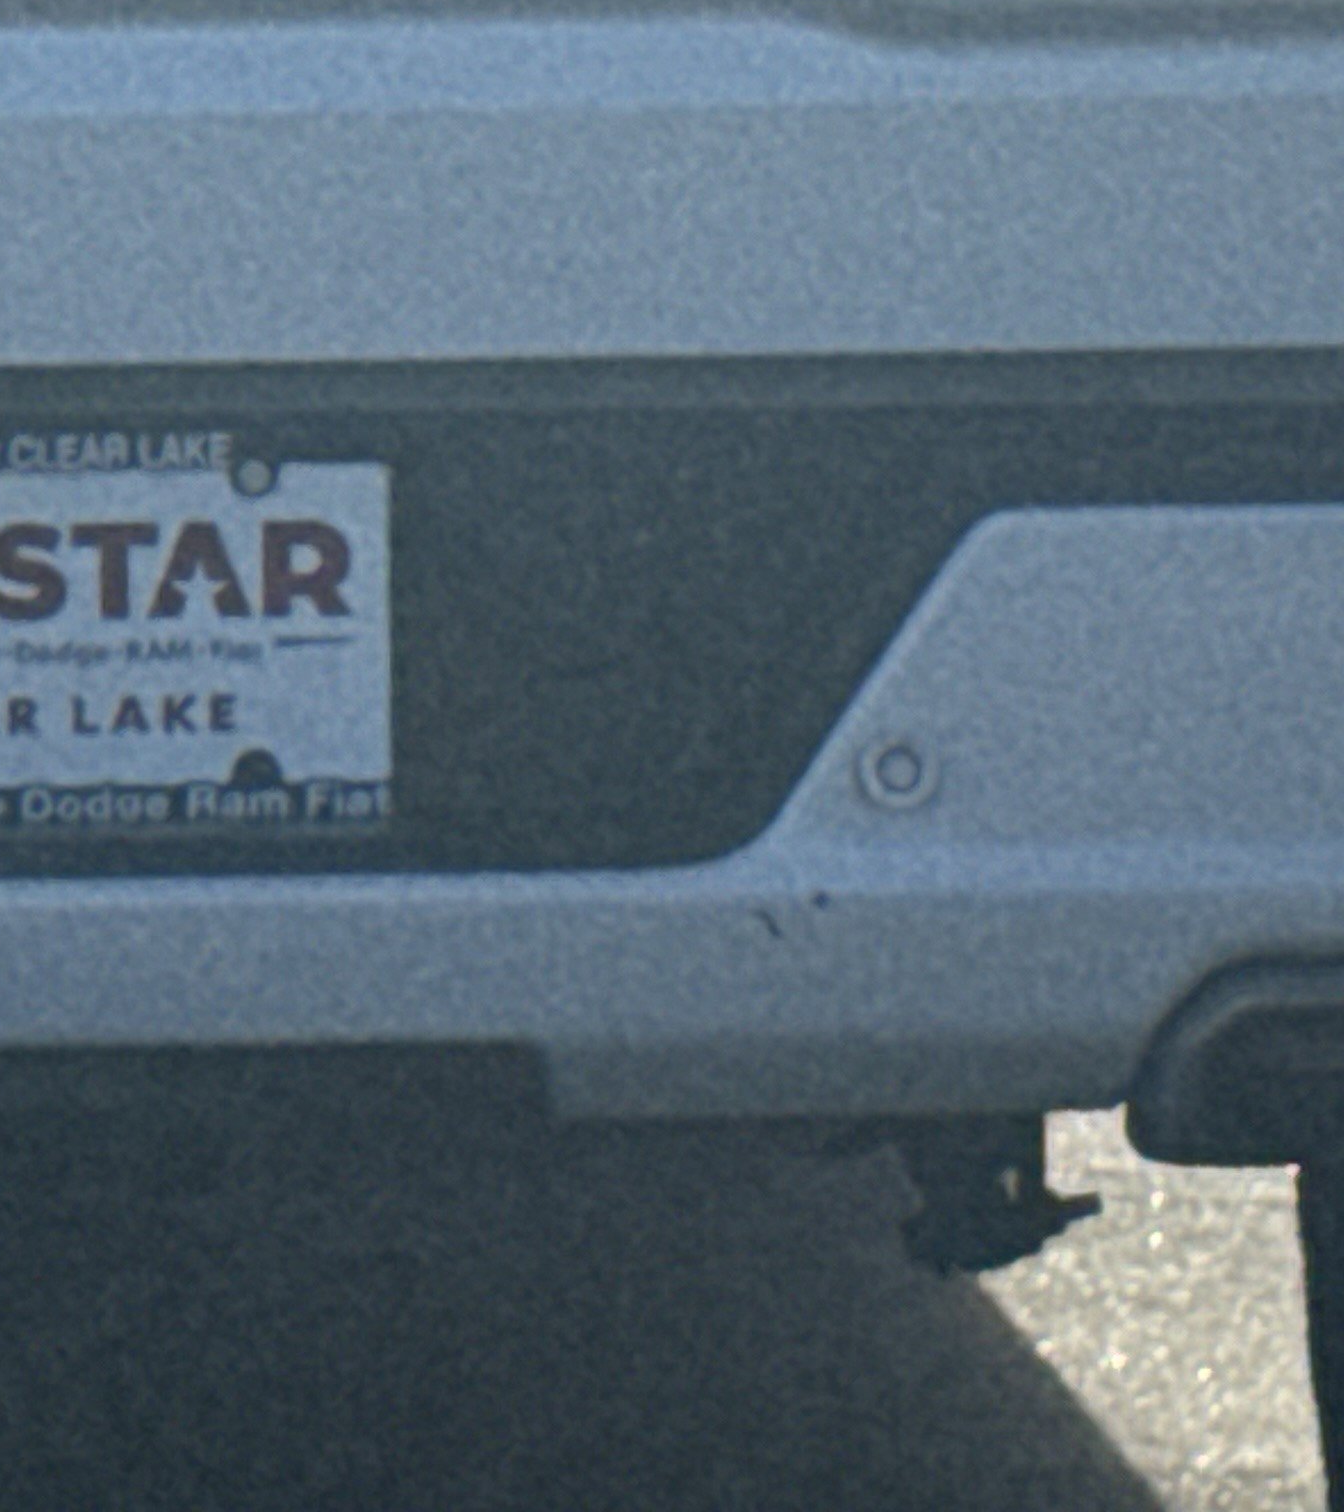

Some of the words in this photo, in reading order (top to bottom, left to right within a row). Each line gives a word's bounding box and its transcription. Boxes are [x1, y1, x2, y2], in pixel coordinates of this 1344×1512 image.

[8, 433, 130, 471] CLEAR
[136, 431, 233, 470] LAKE
[70, 693, 238, 735] LAKE
[20, 785, 173, 824] Dodge
[185, 783, 291, 822] Ram
